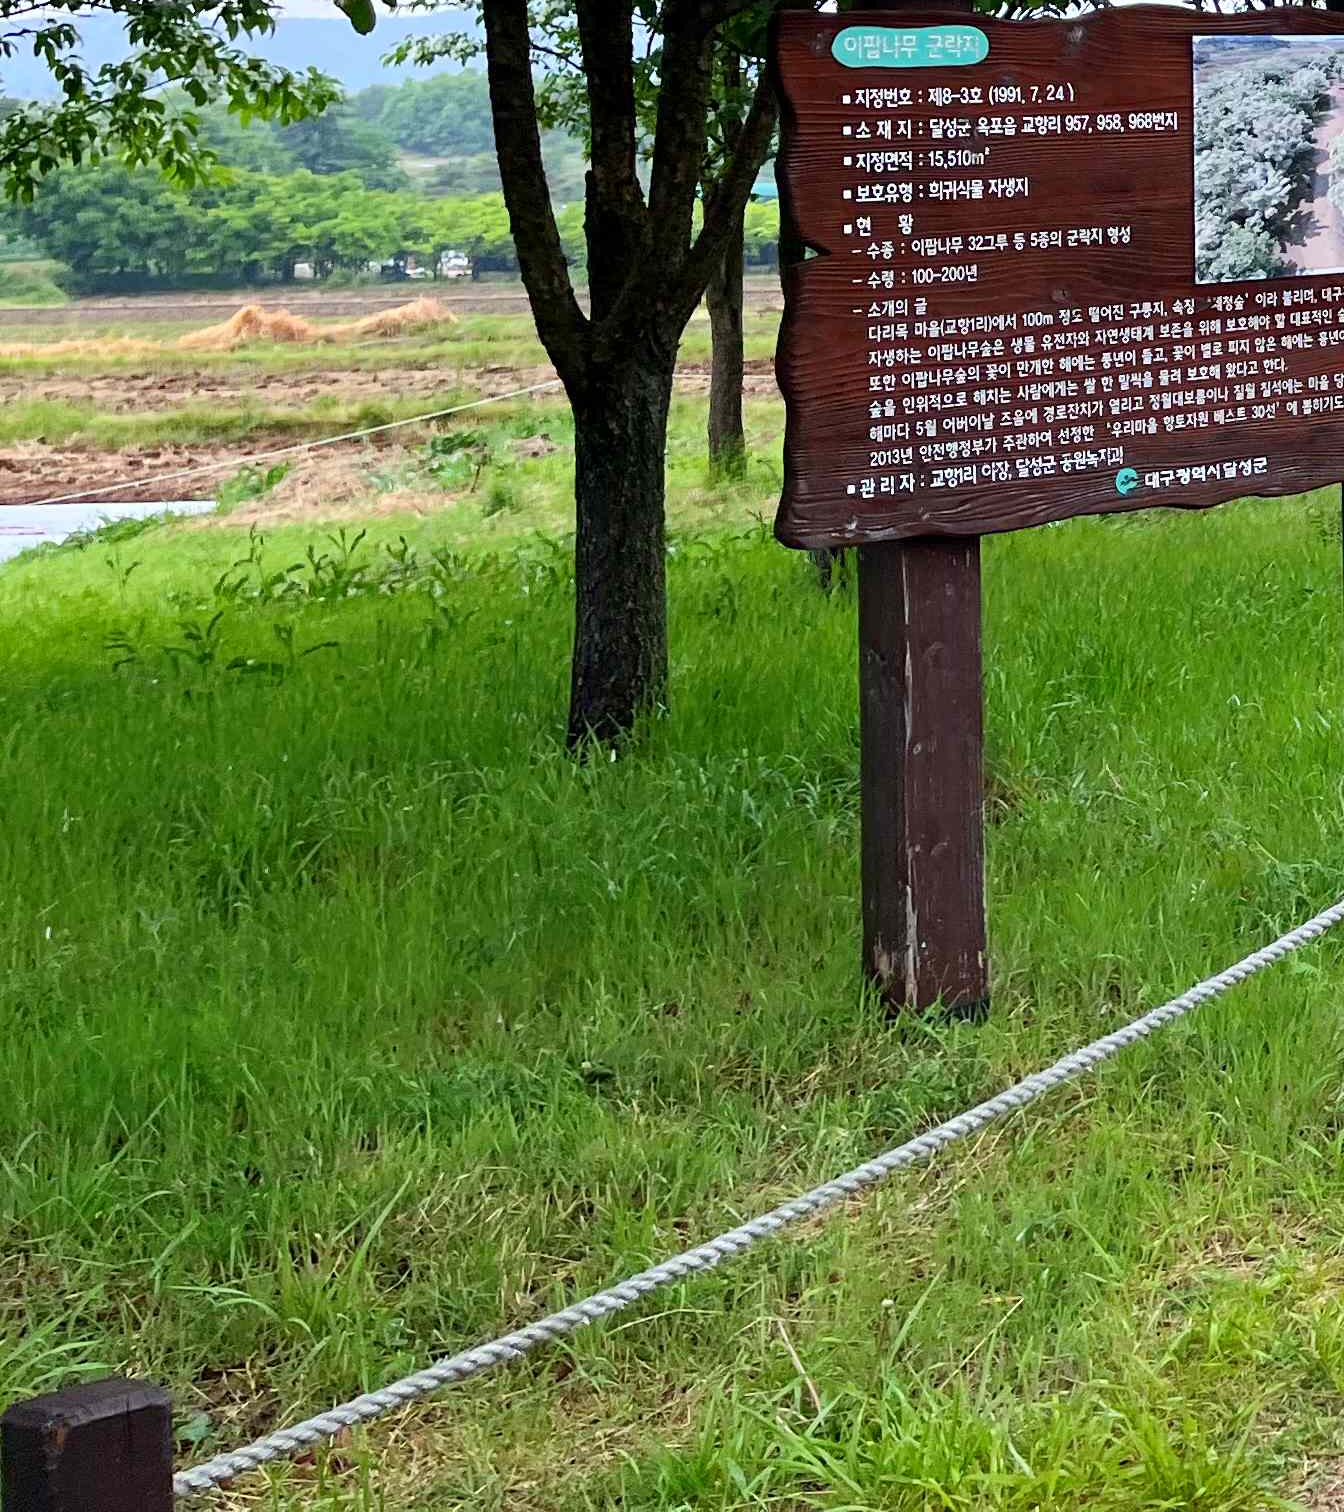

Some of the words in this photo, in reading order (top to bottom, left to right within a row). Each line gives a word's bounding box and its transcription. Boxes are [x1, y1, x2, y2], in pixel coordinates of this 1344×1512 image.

[843, 35, 919, 59] 이팝나무
[925, 35, 980, 59] 군락지
[855, 88, 913, 108] 지정번호
[928, 87, 983, 106] 제8-3호
[929, 118, 971, 138] 달성군
[976, 116, 1017, 136] 옥포읍
[1021, 115, 1061, 135] 교항리
[1065, 115, 1092, 133] 957,
[1096, 114, 1125, 132] 958,
[1129, 112, 1178, 130] 968번지
[855, 151, 913, 172] 지정면적
[855, 183, 913, 203] 보호유형
[929, 179, 984, 201] 희귀식물
[988, 177, 1029, 198] 자생지
[866, 241, 895, 259] 수종
[911, 237, 963, 256] 이팝나무
[968, 234, 1009, 251] 32그루
[1012, 233, 1026, 250] 등
[1030, 230, 1062, 248] 5종의
[1067, 227, 1103, 246] 군락지
[1107, 226, 1131, 244] 형성
[867, 270, 894, 289] 수령
[867, 298, 908, 317] 소개의
[914, 297, 928, 316] 글
[868, 323, 909, 342] 다리목
[1022, 312, 1053, 327] 100m
[1058, 308, 1083, 325] 정도
[1088, 304, 1124, 323] 떨어진
[1282, 288, 1318, 306] 불리며,
[868, 348, 922, 367] 자생하는
[927, 338, 1005, 361] 이팝나무숲은
[1011, 336, 1035, 355] 생물
[1041, 331, 1090, 351] 유전자와
[1095, 325, 1154, 345] 자연생태계
[1159, 321, 1193, 338] 보존을
[1198, 319, 1221, 336] 위해
[1226, 315, 1270, 332] 보호해야
[1274, 313, 1285, 329] 할
[1290, 309, 1332, 326] 대표적인
[869, 374, 896, 392] 또한
[902, 366, 980, 389] 이팝나무숲의
[986, 362, 1011, 381] 꽃이
[1016, 358, 1054, 377] 만개한
[1059, 354, 1096, 373] 해에는
[1101, 350, 1136, 369] 풍년이
[1172, 345, 1196, 361] 꽃이
[1200, 341, 1223, 359] 별로
[1228, 339, 1250, 355] 피지
[1254, 336, 1277, 353] 않은
[1281, 333, 1313, 350] 해에는
[868, 399, 897, 419] 숲을
[902, 391, 968, 415] 인위적으로
[973, 387, 1012, 406] 해치는
[1017, 379, 1078, 401] 사람에게는
[1084, 377, 1096, 394] 쌀
[1101, 376, 1114, 392] 한
[1118, 371, 1153, 391] 말씩을
[1159, 368, 1182, 386] 물려
[1186, 364, 1221, 381] 보호해
[1226, 360, 1259, 378] 왔다고
[869, 423, 910, 443] 해마다
[916, 419, 937, 437] 5월
[943, 412, 995, 434] 어버이날
[1000, 407, 1038, 427] 즈음에
[1043, 399, 1104, 423] 경로잔치가
[1109, 396, 1145, 415] 열리고
[1149, 386, 1229, 410] 정월대보름이나
[1308, 374, 1329, 391] 마을
[870, 446, 913, 467] 2013년
[919, 437, 997, 463] 안전행정부가
[1002, 429, 1053, 452] 주관하여
[1057, 424, 1095, 445] 선정한
[1163, 410, 1209, 432] 향토자원
[1213, 407, 1248, 425] 베스트
[1302, 395, 1344, 415] 뽑히기도
[930, 464, 977, 488] 교항1리
[1015, 455, 1057, 478] 달성군
